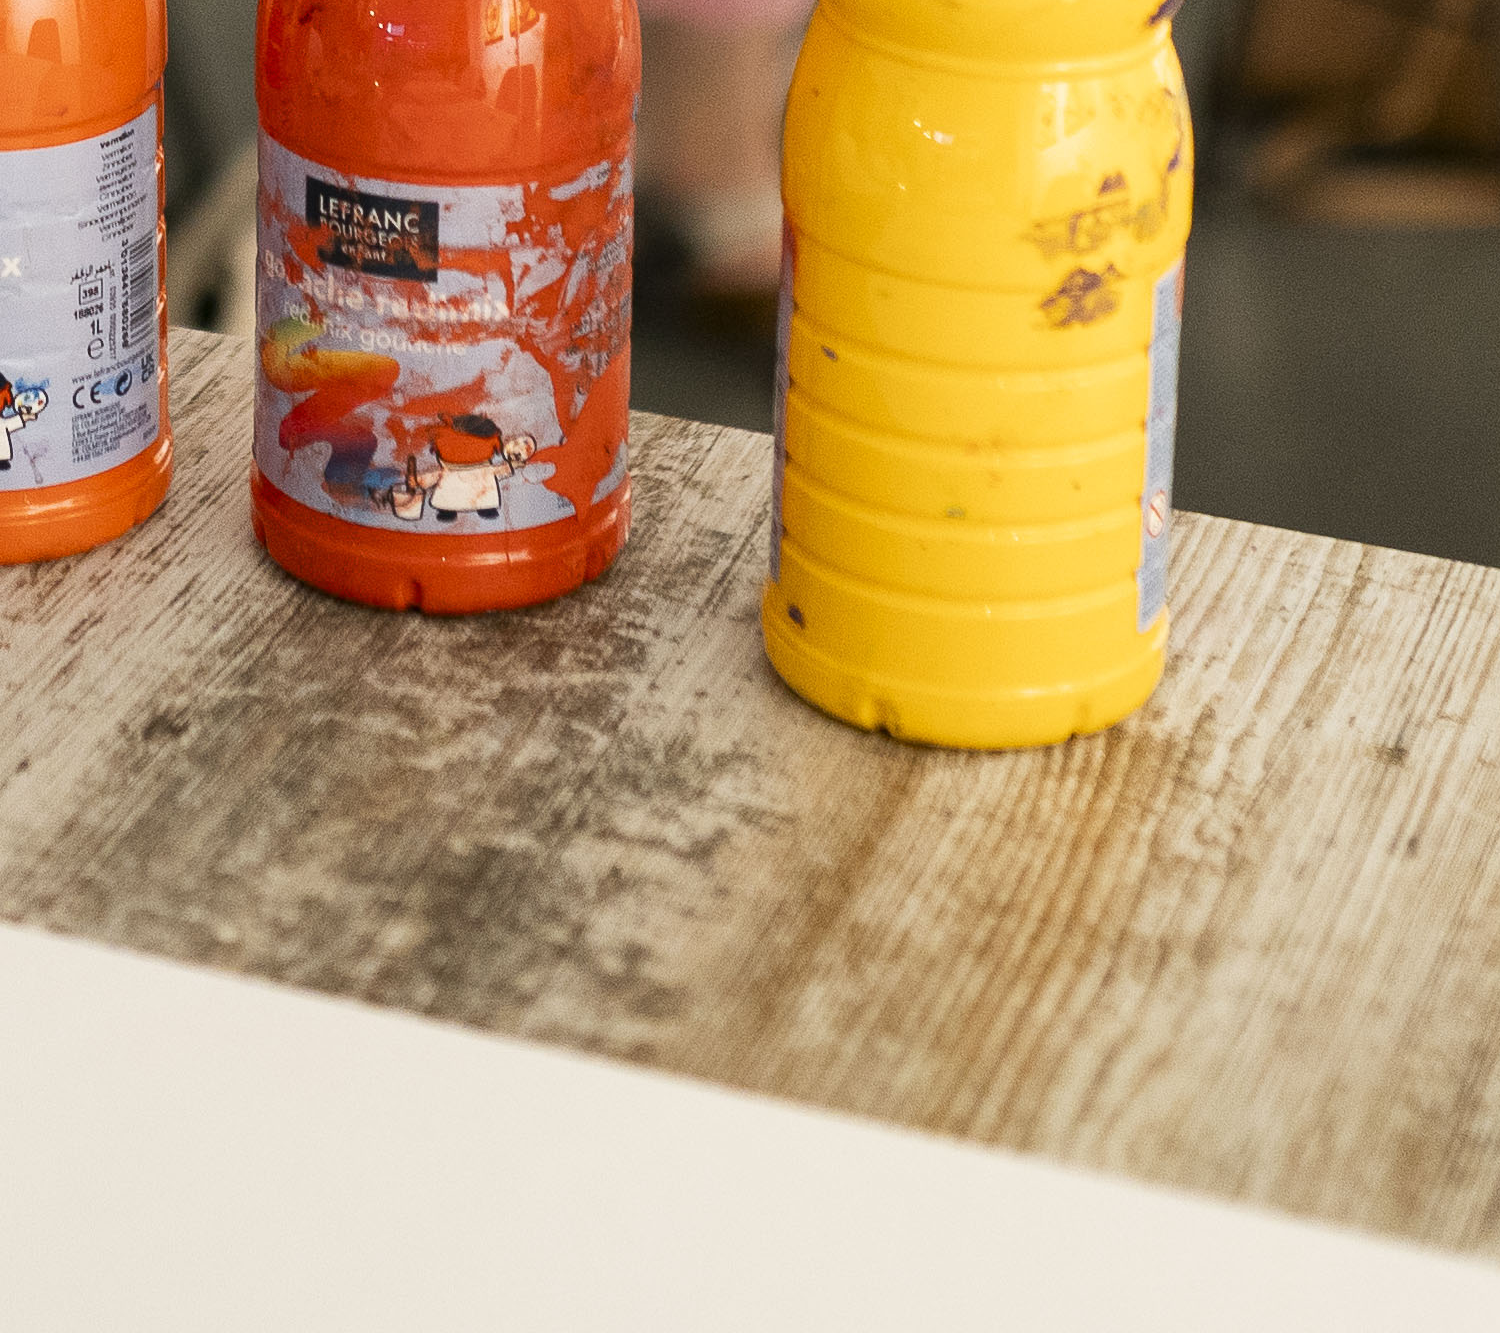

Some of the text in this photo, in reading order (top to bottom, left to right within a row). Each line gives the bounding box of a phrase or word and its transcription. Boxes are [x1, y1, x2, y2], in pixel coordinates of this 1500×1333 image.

[319, 194, 420, 234] LEFRANC
[90, 318, 103, 336] 1L
[72, 379, 102, 409] CE
